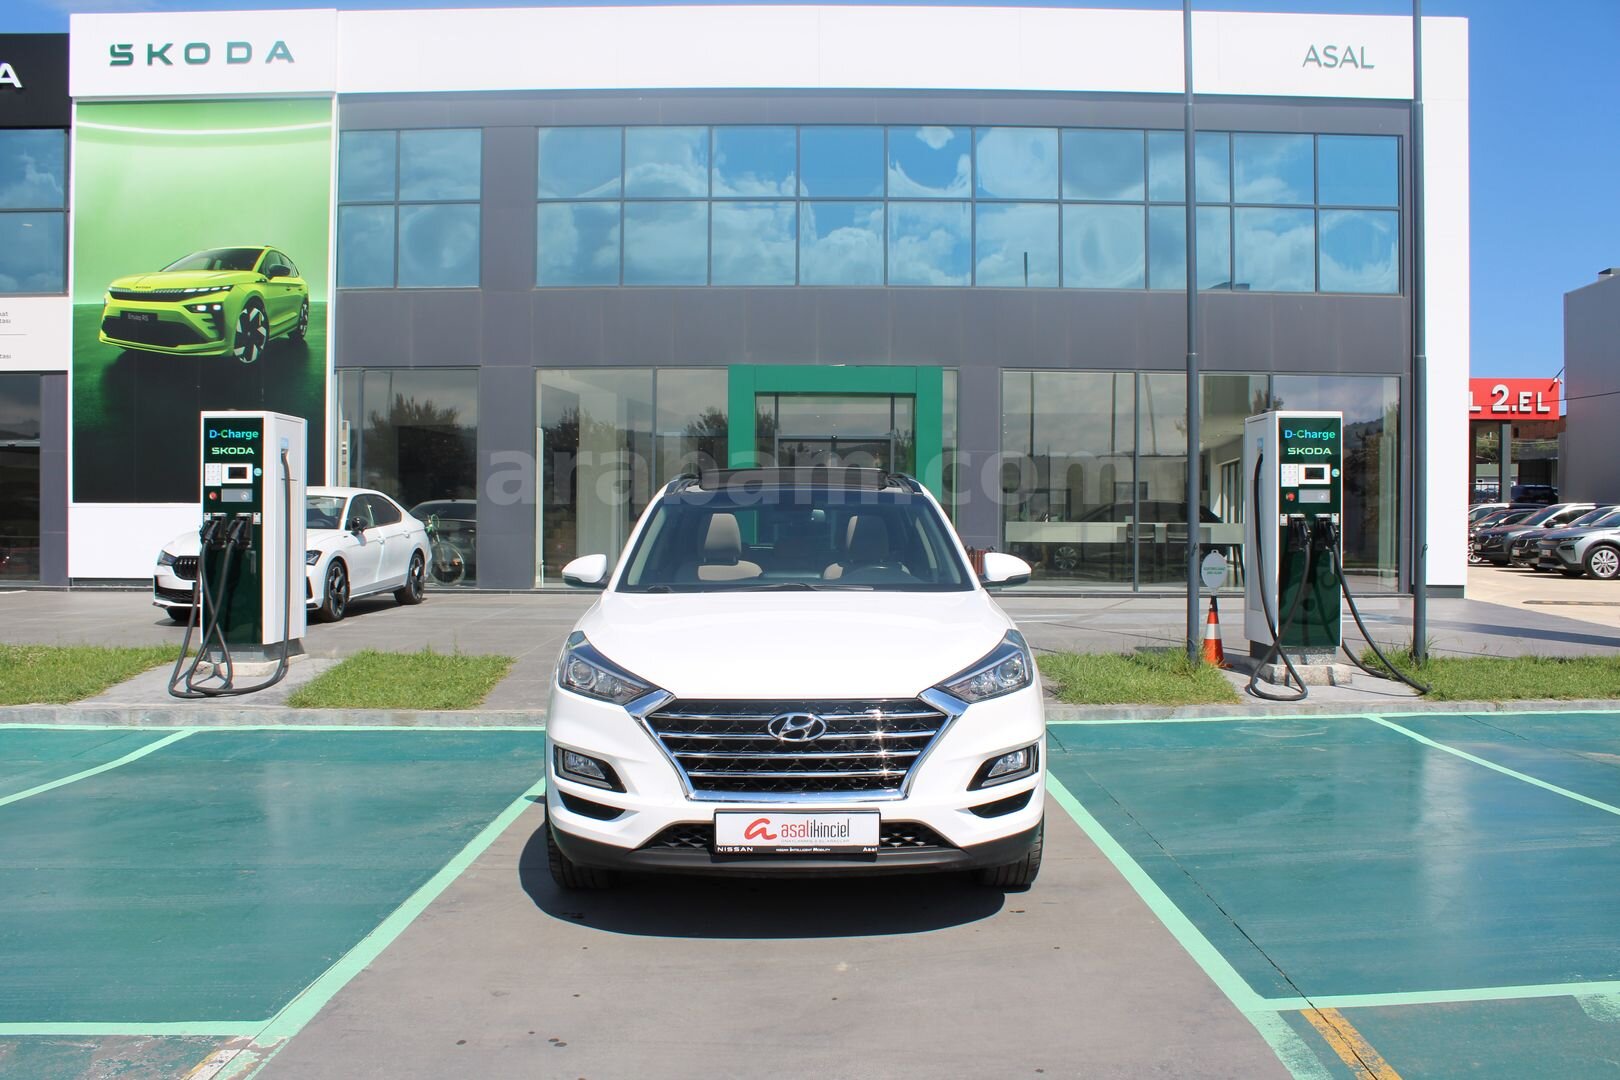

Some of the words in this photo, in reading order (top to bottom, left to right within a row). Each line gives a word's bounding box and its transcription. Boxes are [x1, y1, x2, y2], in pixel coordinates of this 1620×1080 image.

[1302, 44, 1375, 69] ASAL
[1469, 391, 1482, 411] L
[1491, 384, 1551, 413] 2.EL
[209, 429, 259, 440] D-Charge
[1284, 429, 1336, 440] D-Charge
[211, 447, 255, 455] SKODA
[1287, 447, 1332, 455] SKODA
[781, 818, 850, 838] asalikinciel
